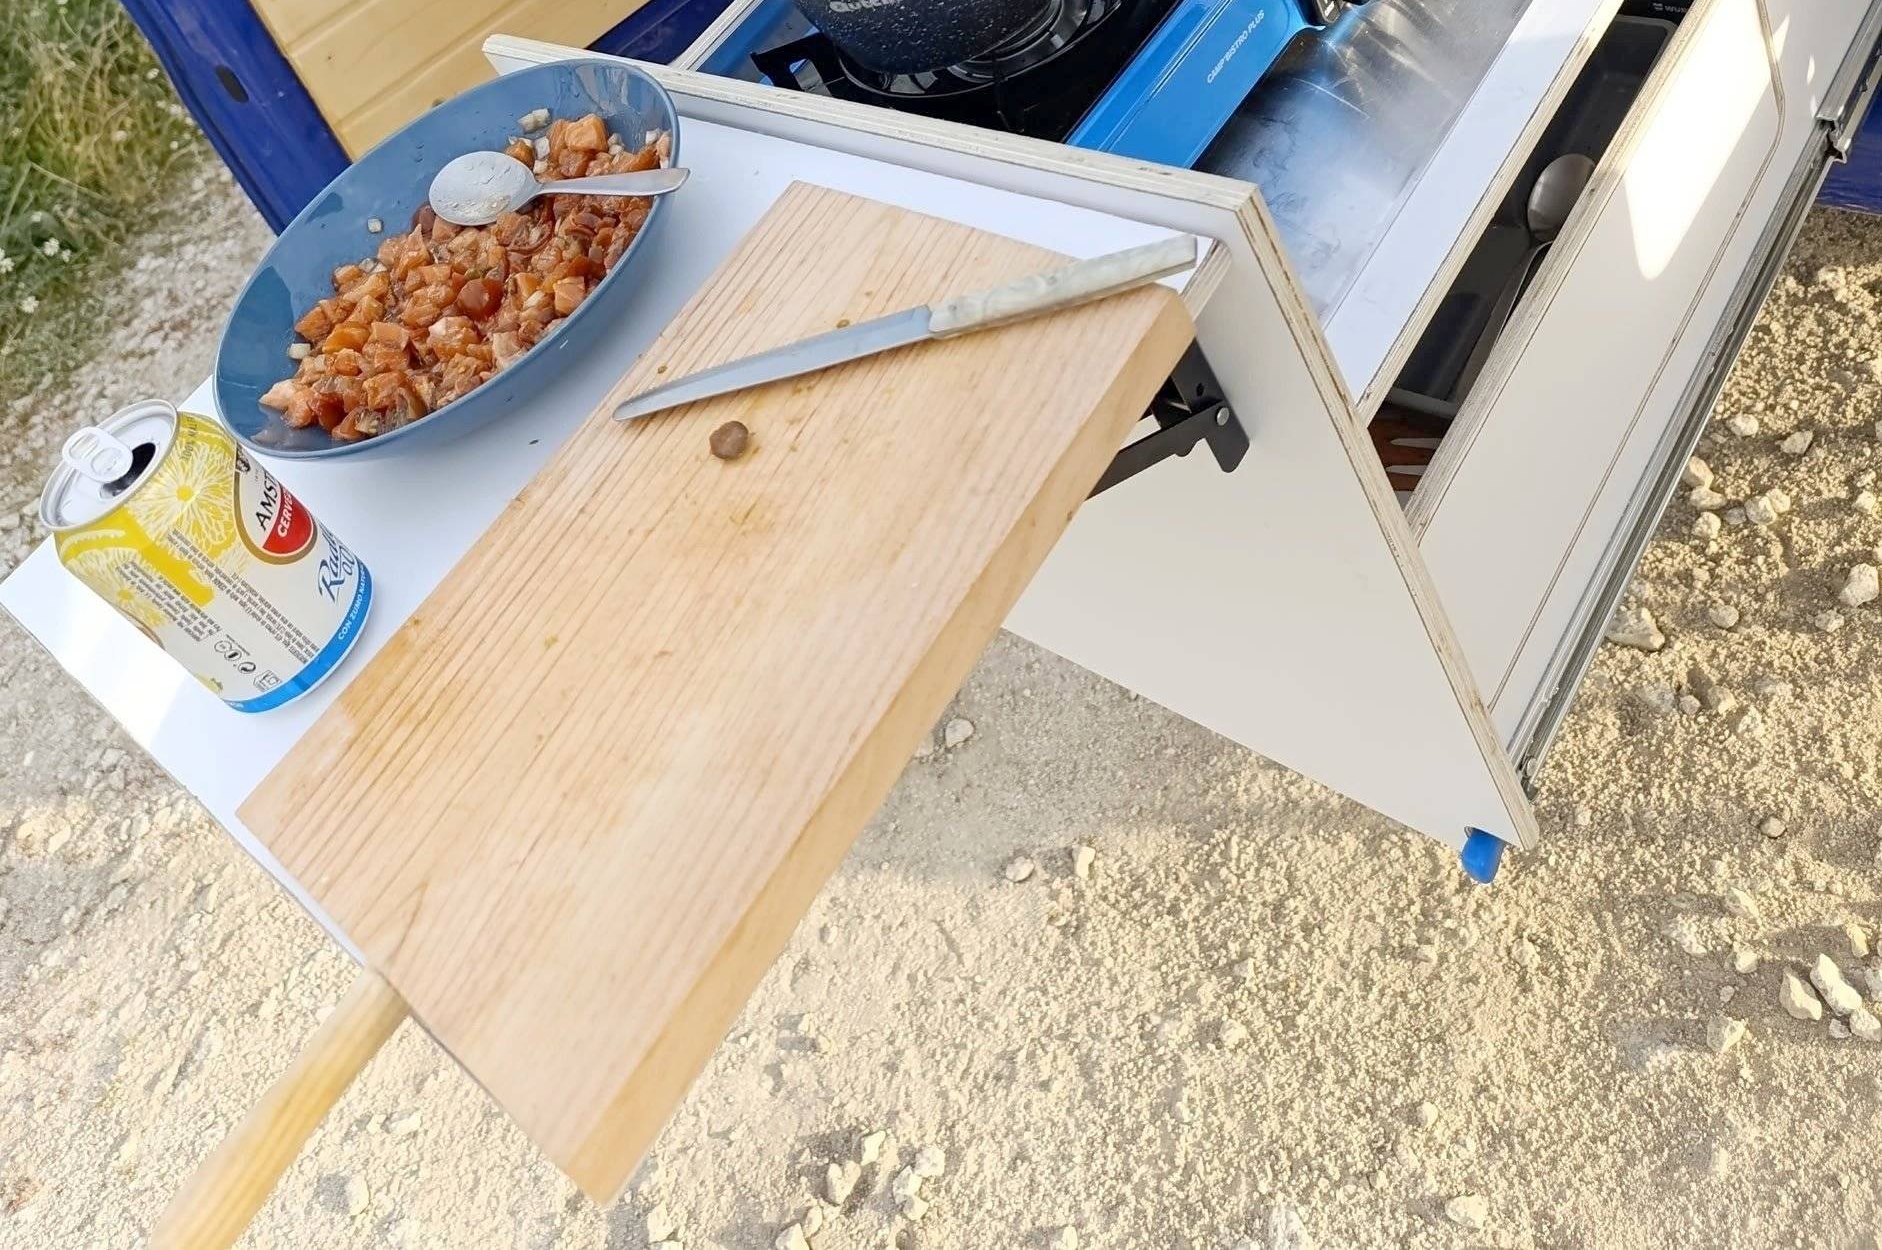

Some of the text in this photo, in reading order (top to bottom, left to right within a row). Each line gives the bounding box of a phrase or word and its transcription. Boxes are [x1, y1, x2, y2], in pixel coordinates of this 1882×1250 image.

[1248, 9, 1265, 33] PLUS
[255, 469, 278, 531] AMST
[277, 488, 294, 538] CERVE
[338, 619, 352, 640] CON
[349, 594, 363, 620] ZUMO
